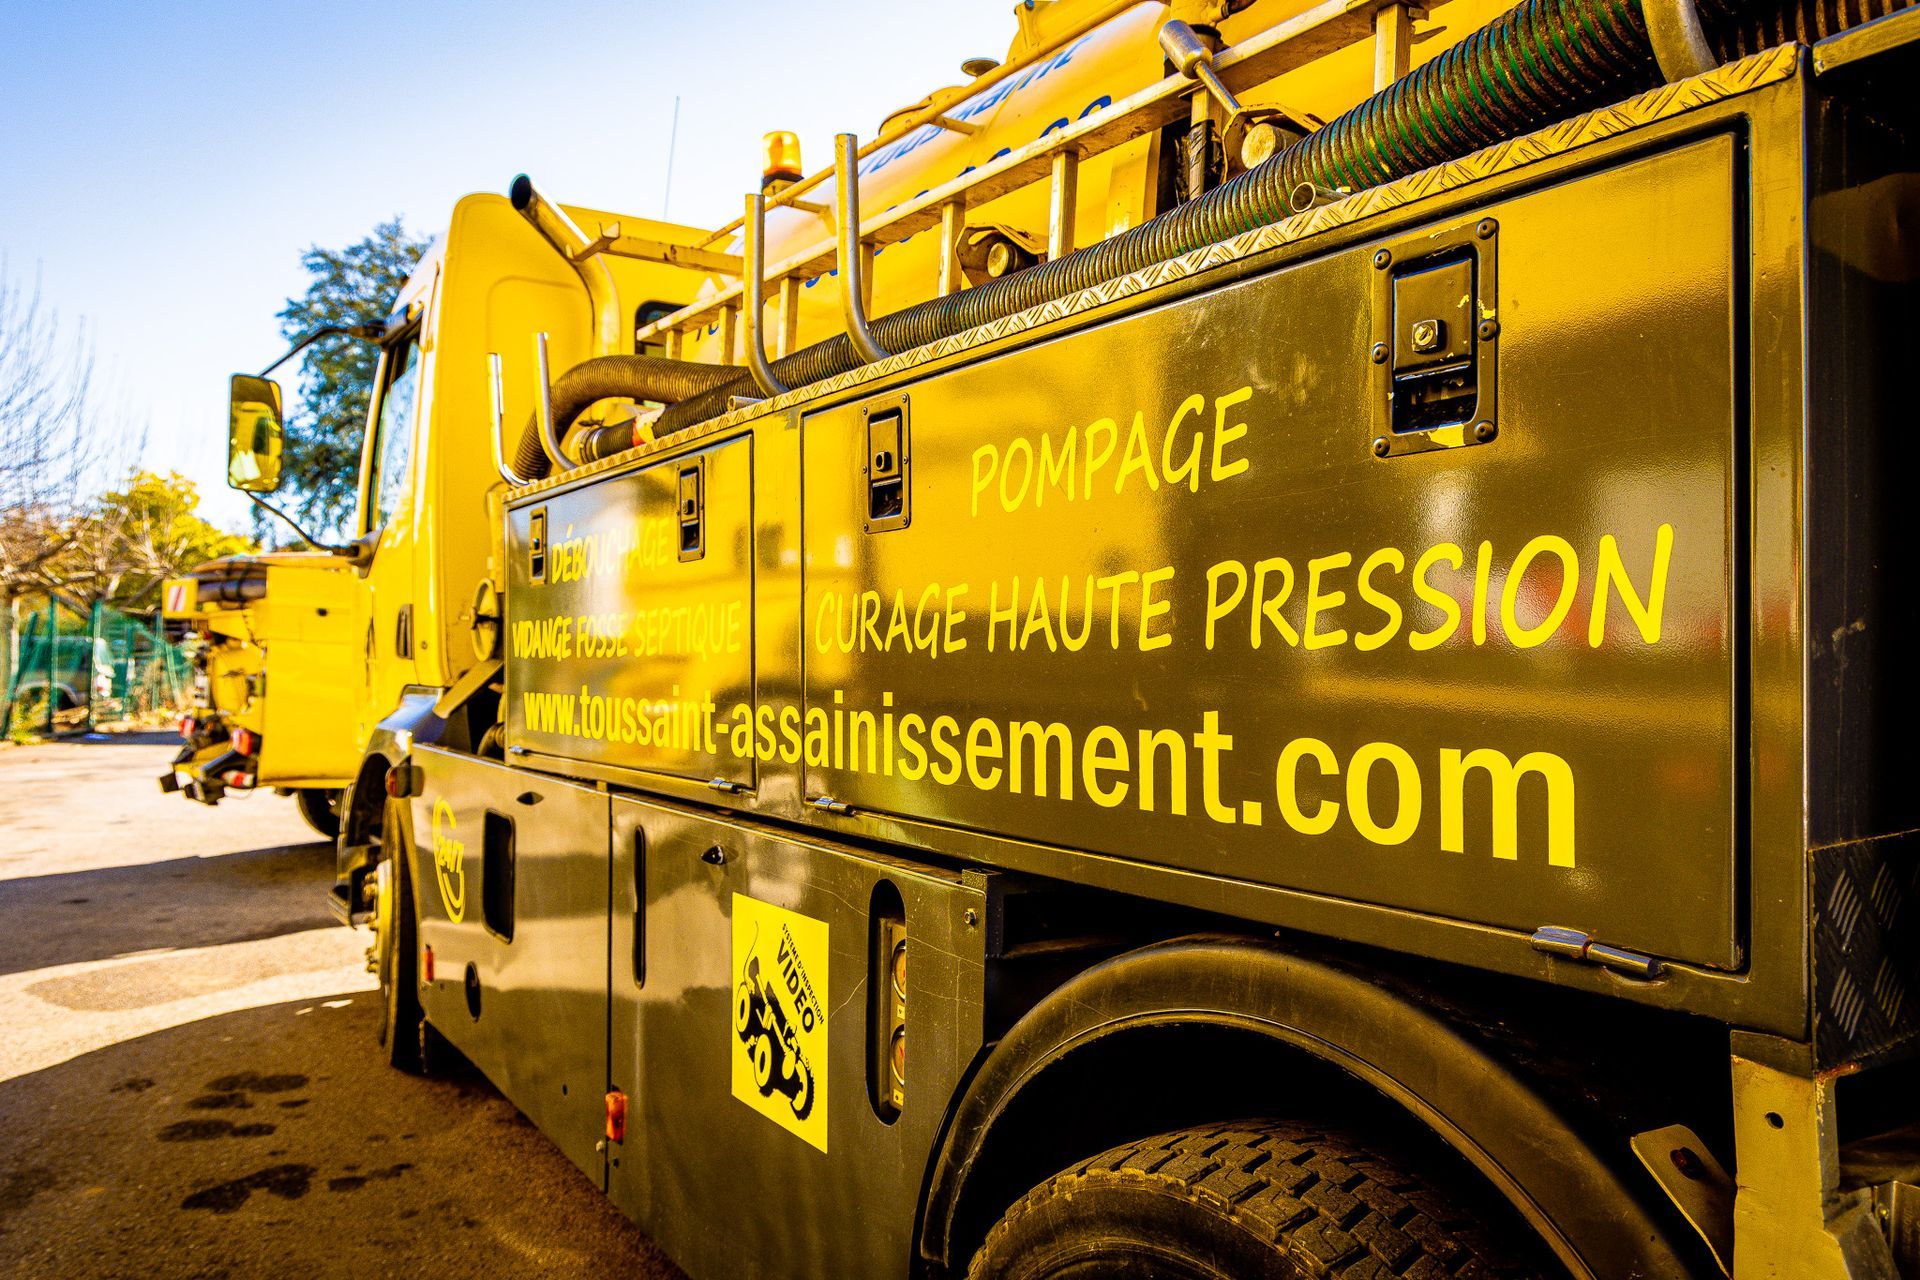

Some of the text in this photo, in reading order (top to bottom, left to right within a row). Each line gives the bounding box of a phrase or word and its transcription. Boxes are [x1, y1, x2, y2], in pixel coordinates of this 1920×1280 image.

[971, 386, 1253, 518] POMPAGE
[551, 518, 669, 584] DÉBOUCHAGE
[815, 523, 1674, 659] CURAGE HAUTE PRESSION
[512, 600, 741, 662] VIDANGE FOSSE SEPTIQUE
[523, 684, 1576, 869] www.toussaint-assainissement.com
[777, 938, 815, 1034] VIDEO
